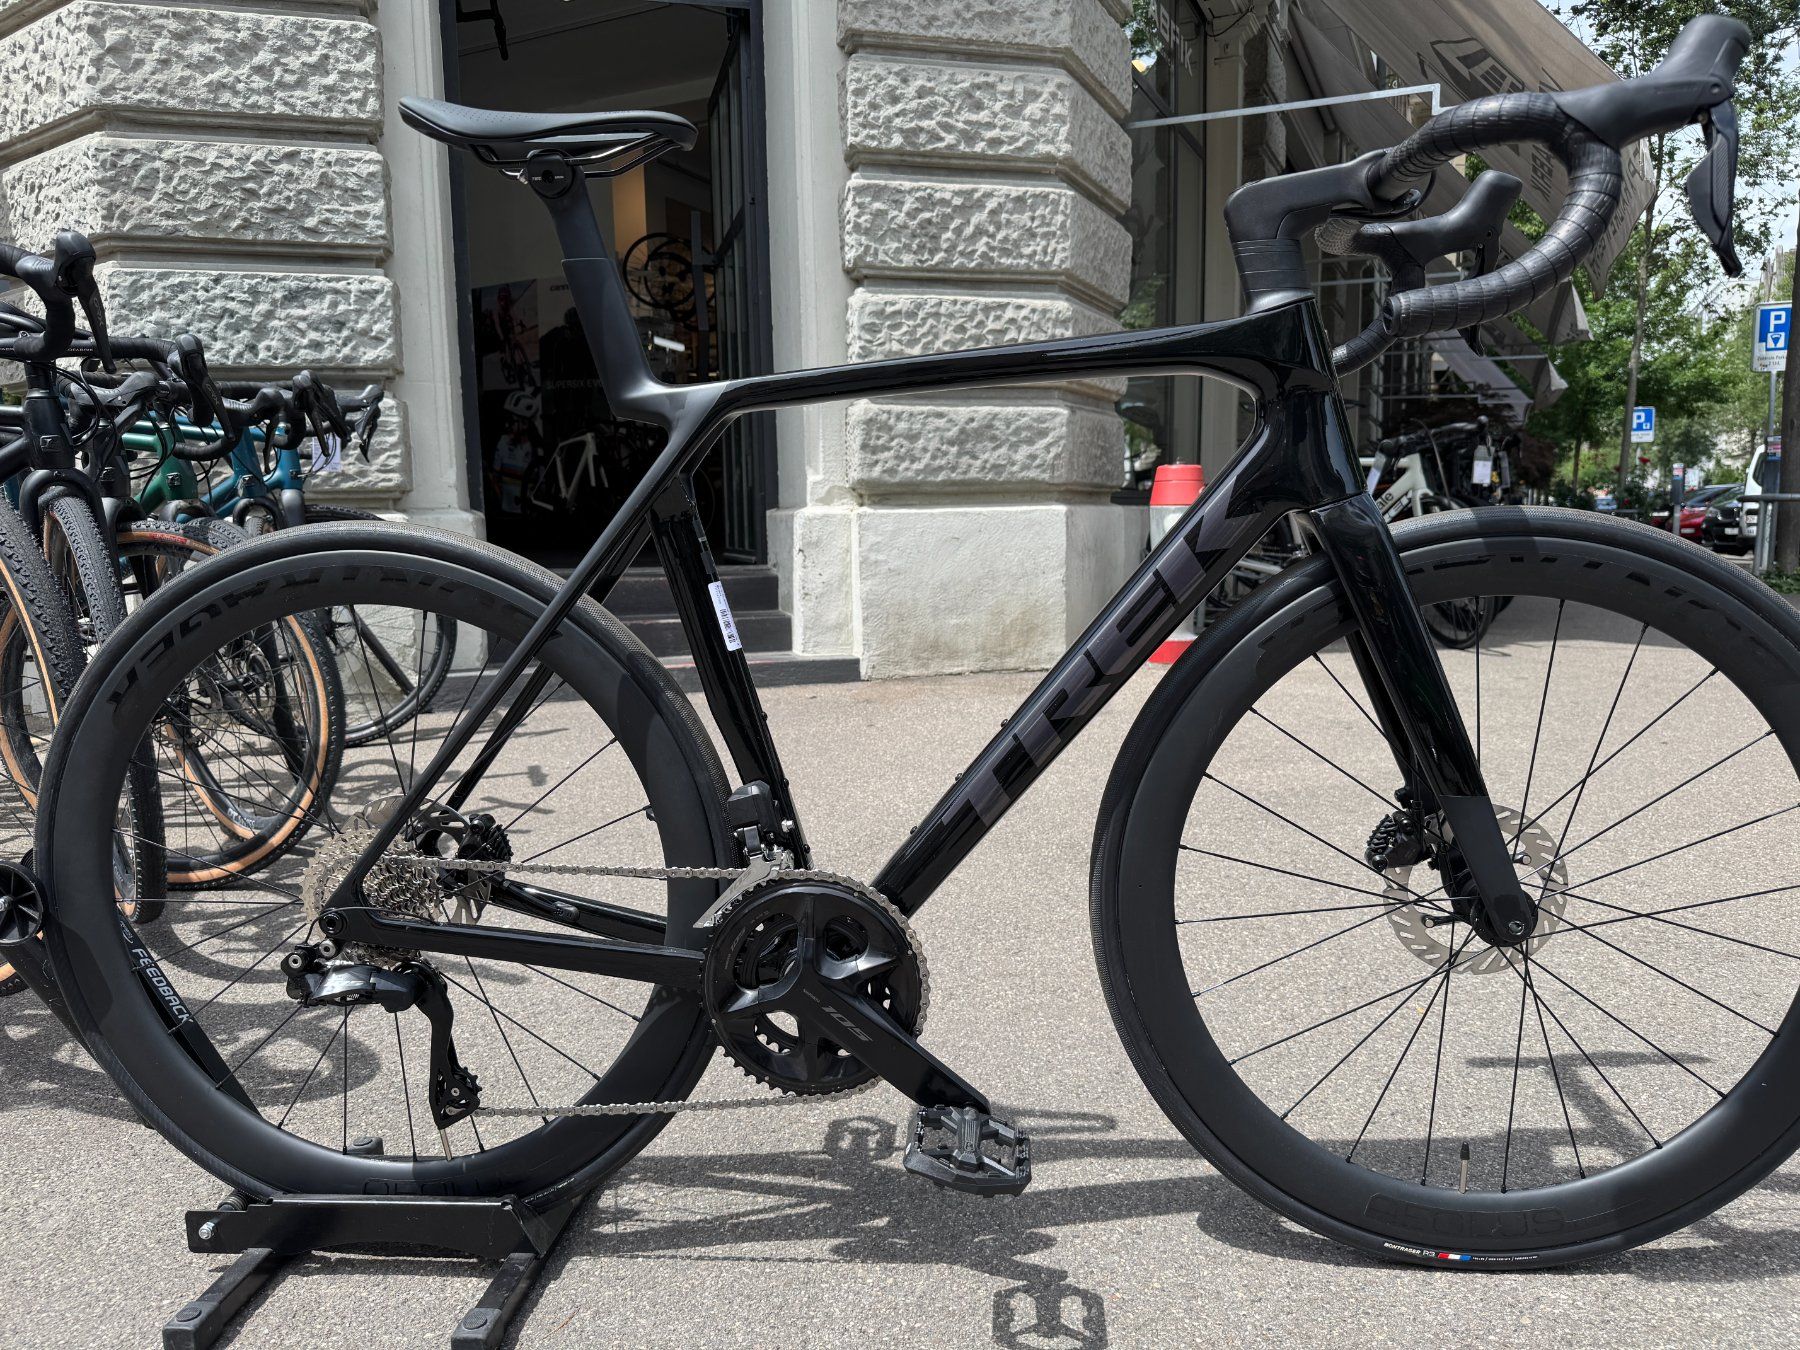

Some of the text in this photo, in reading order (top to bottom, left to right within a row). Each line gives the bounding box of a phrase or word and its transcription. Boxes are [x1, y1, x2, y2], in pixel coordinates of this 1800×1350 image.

[1770, 311, 1786, 332] P
[1632, 412, 1646, 429] P
[941, 476, 1262, 828] TREK
[132, 948, 193, 1023] FEEDBACK
[821, 1006, 874, 1042] 105
